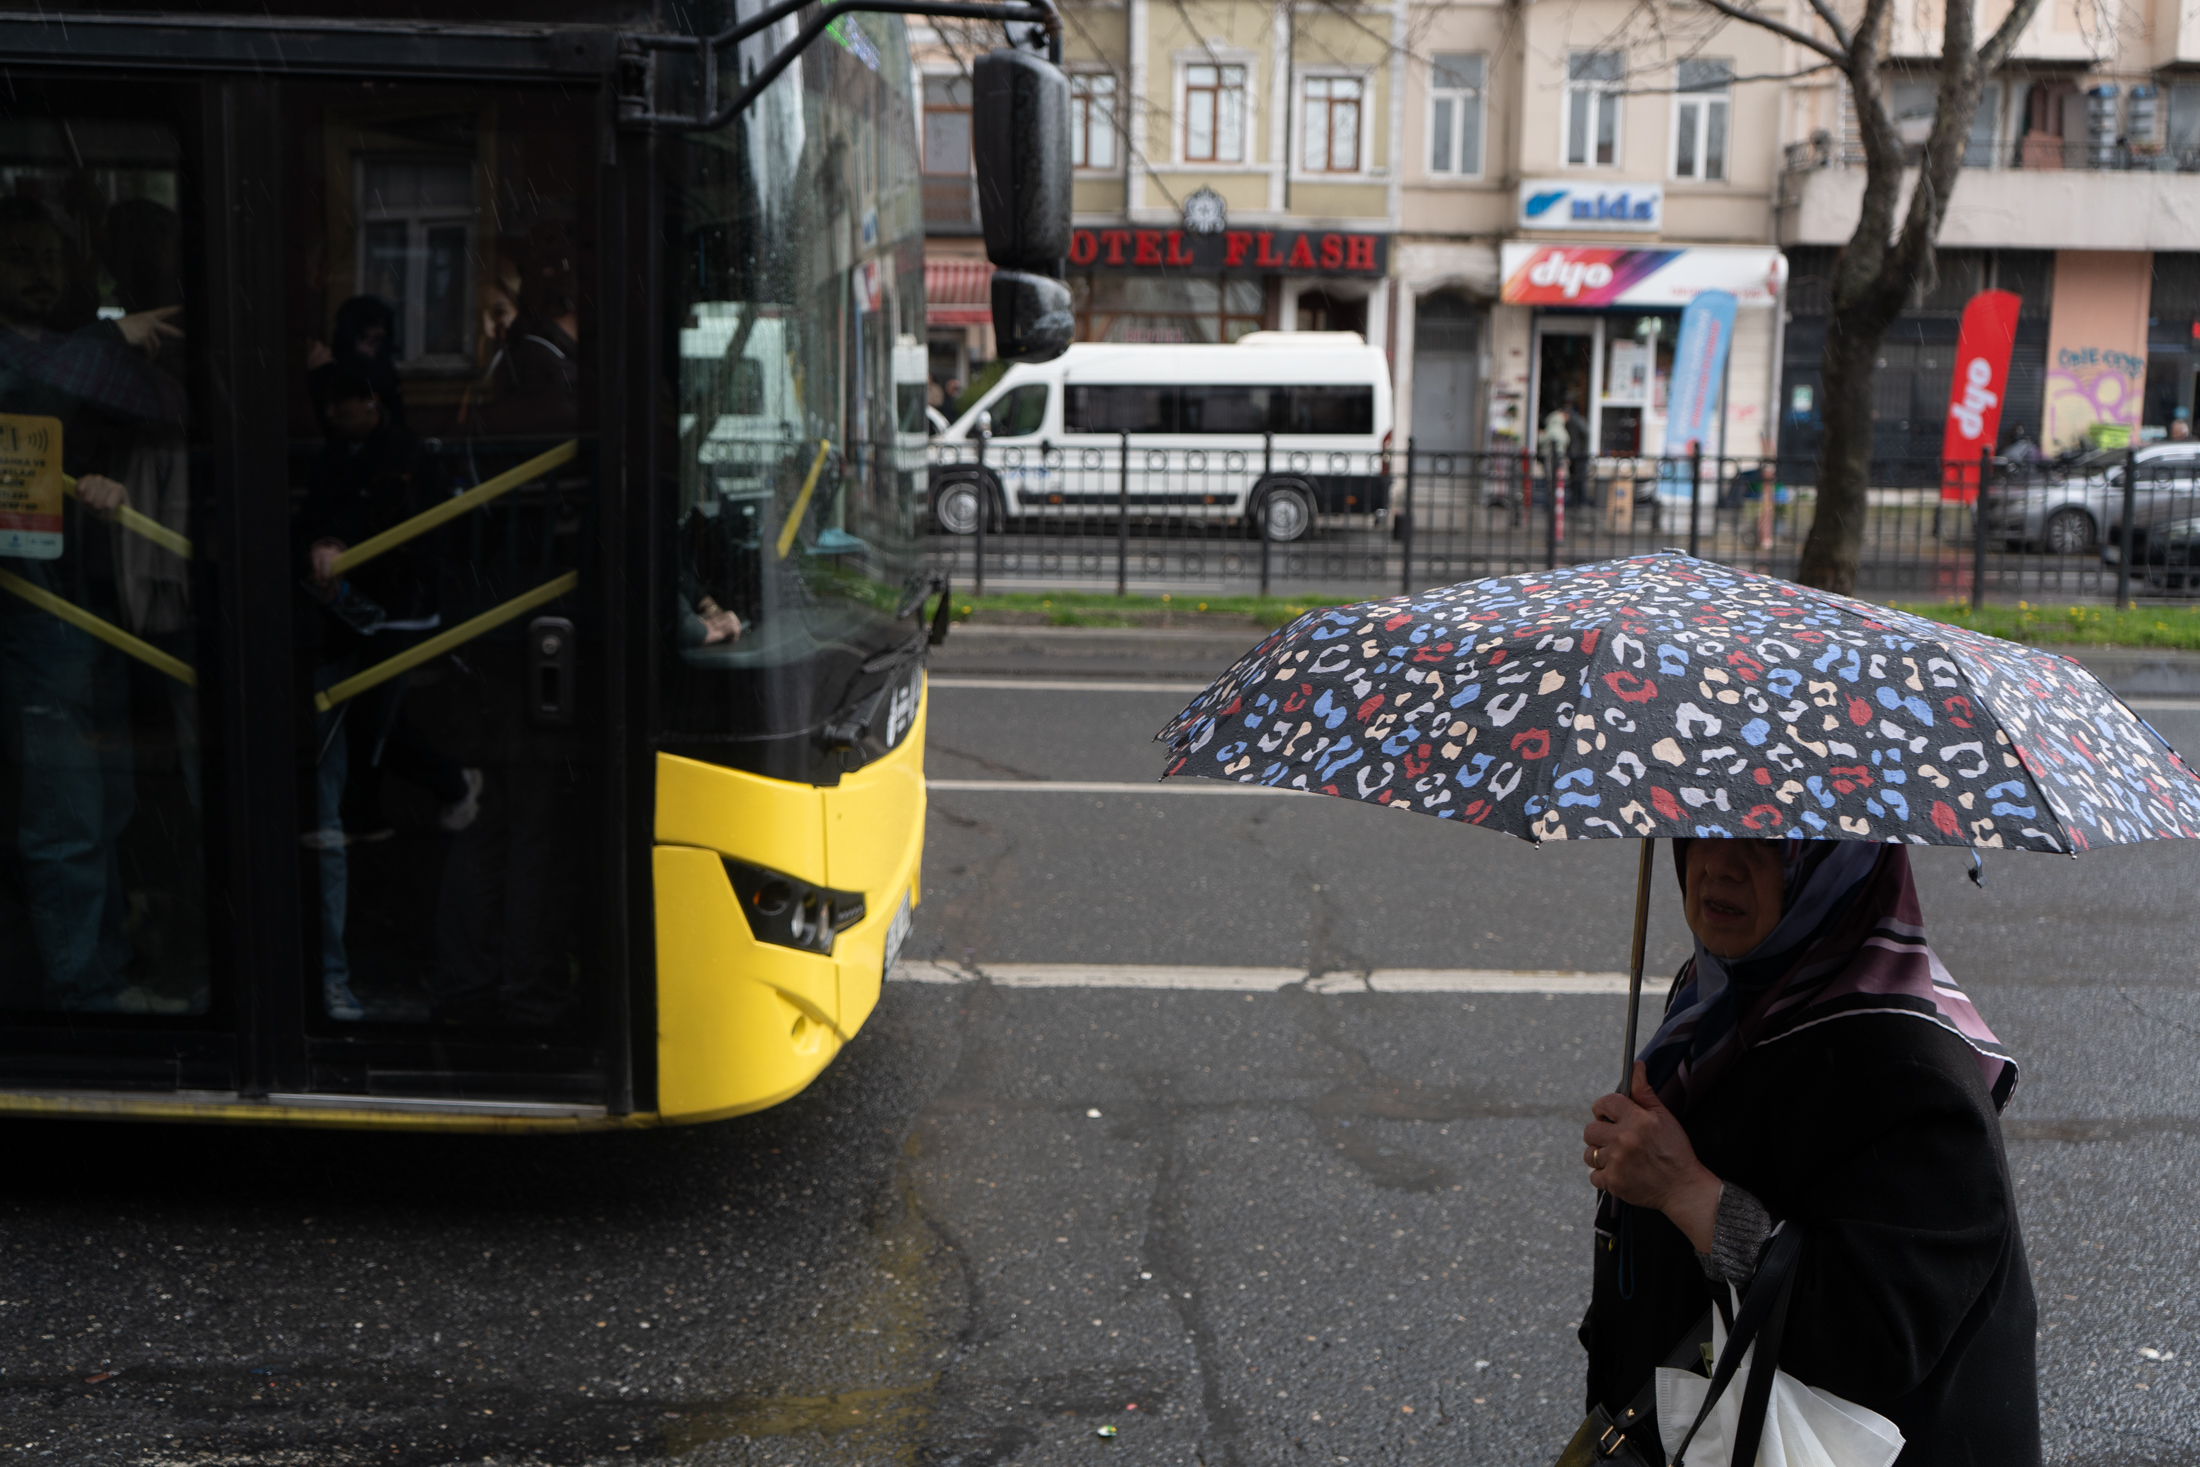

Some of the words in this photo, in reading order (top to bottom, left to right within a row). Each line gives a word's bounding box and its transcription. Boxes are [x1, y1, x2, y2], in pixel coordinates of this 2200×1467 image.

[1068, 229, 1195, 266] OTEL
[1223, 230, 1379, 271] FLASH
[1529, 251, 1614, 298] dyo
[1951, 356, 1998, 440] dyo
